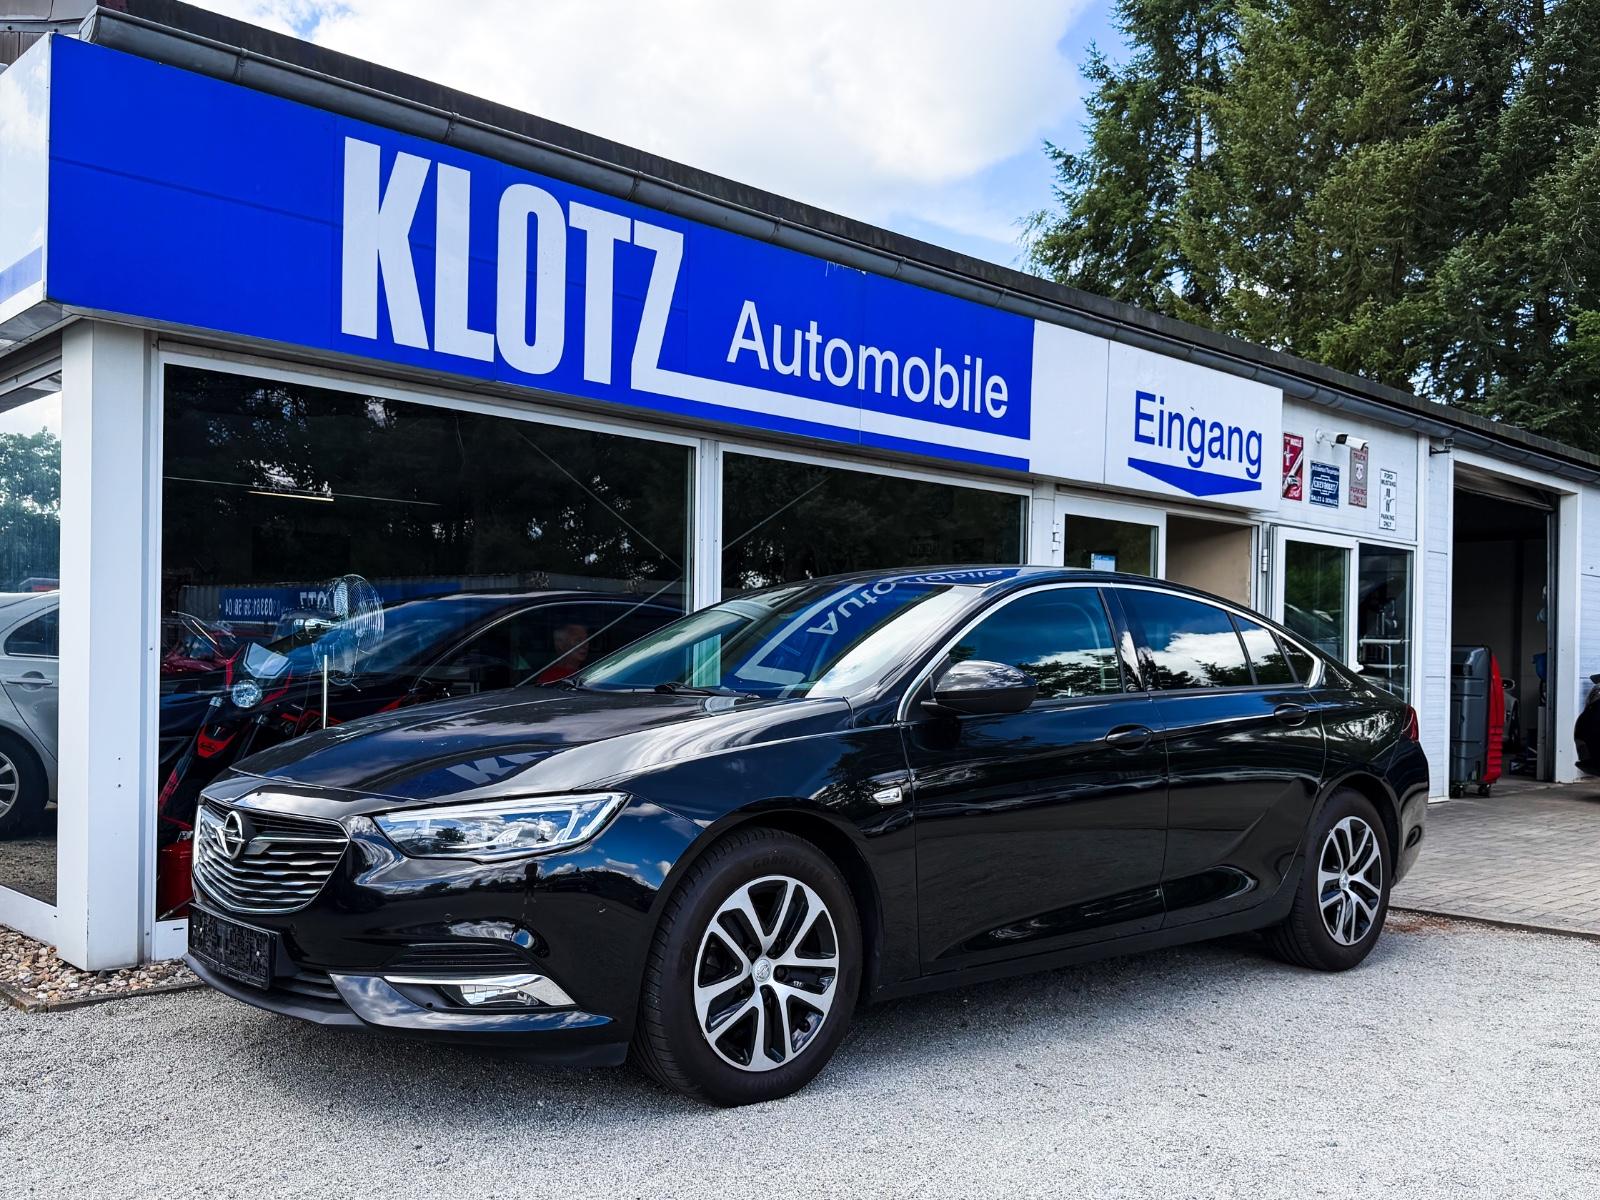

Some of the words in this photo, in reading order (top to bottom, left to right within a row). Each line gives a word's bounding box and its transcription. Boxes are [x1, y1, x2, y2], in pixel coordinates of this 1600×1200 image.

[341, 136, 684, 390] KLOTZ
[726, 300, 1009, 419] Automobile
[1134, 390, 1263, 479] Eingang
[1353, 451, 1366, 461] TRUCK
[1350, 486, 1367, 496] PARKING
[1380, 513, 1395, 521] PARKING
